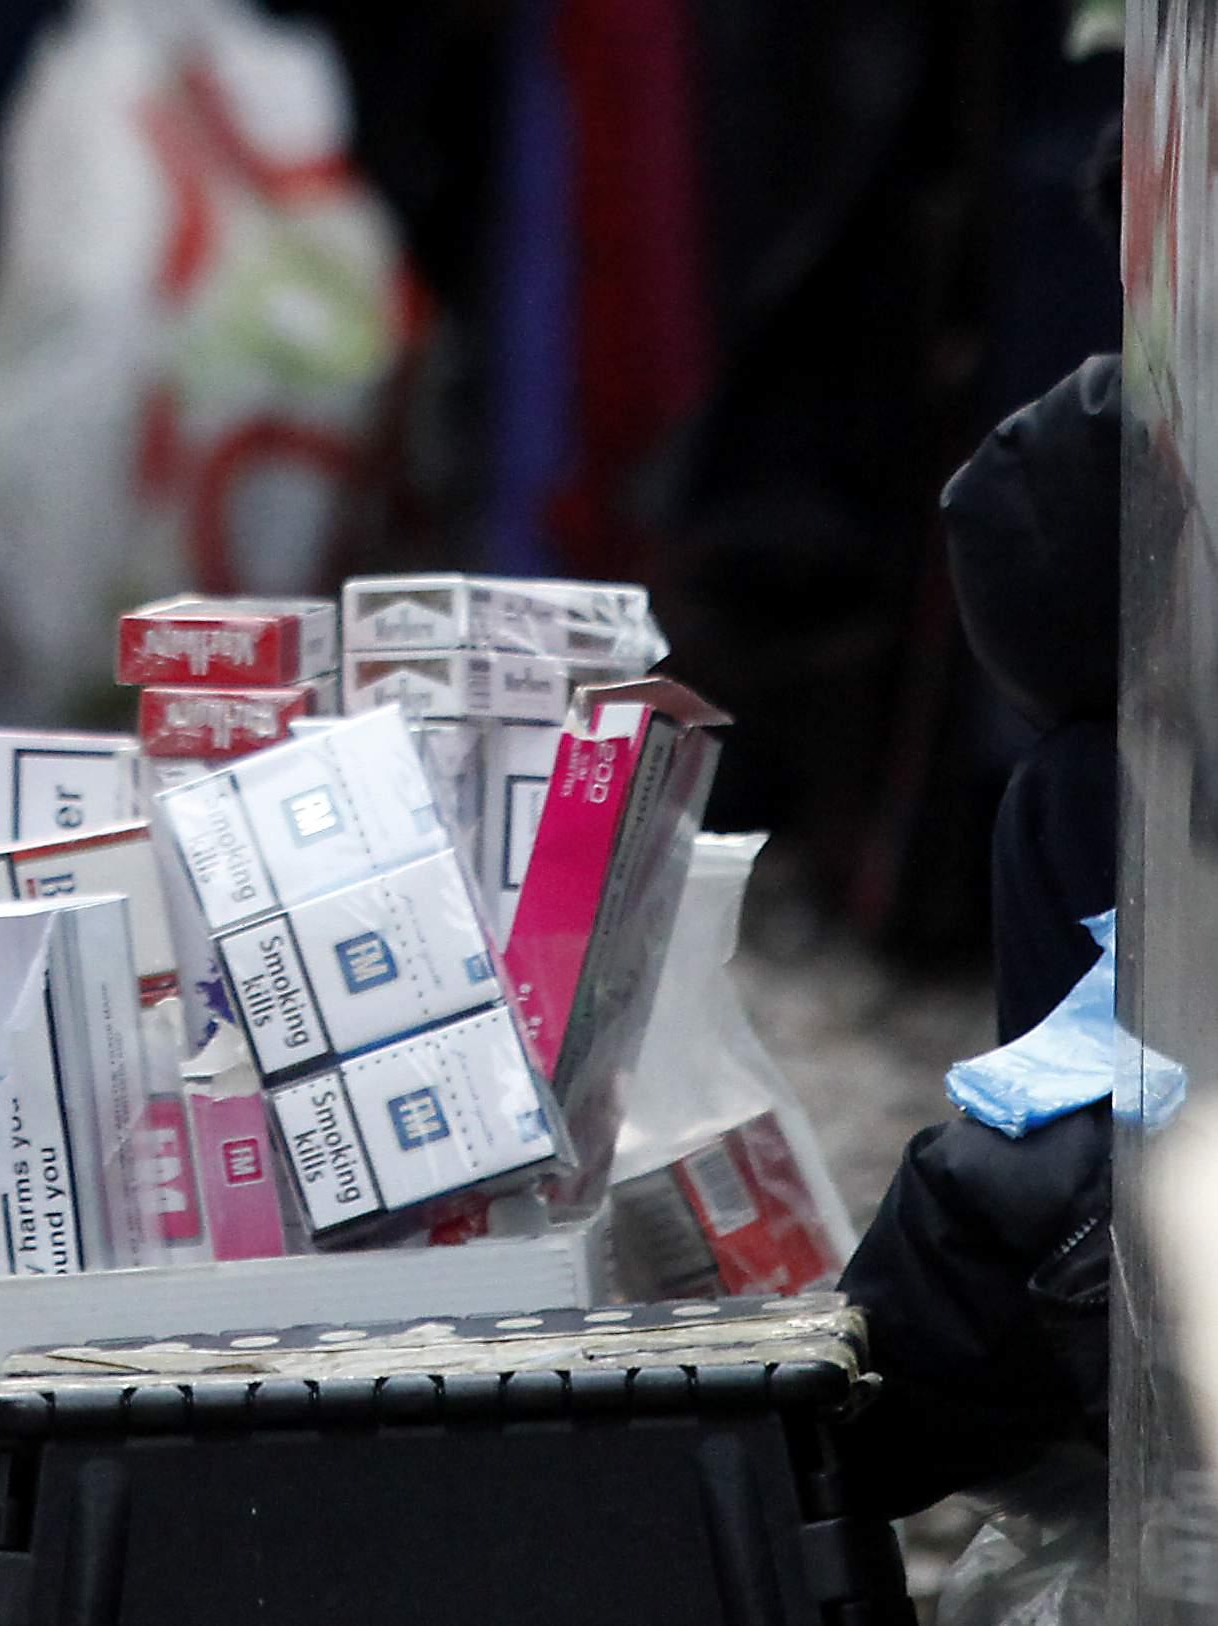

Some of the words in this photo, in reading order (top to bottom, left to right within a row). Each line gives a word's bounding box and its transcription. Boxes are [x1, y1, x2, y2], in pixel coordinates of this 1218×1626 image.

[242, 974, 275, 1028] kills
[260, 935, 310, 1049] Smoking
[10, 1097, 30, 1149] yo
[312, 1091, 360, 1204] Smoking
[41, 1147, 65, 1200] you
[293, 1127, 326, 1185] kills
[14, 1161, 37, 1253] harms
